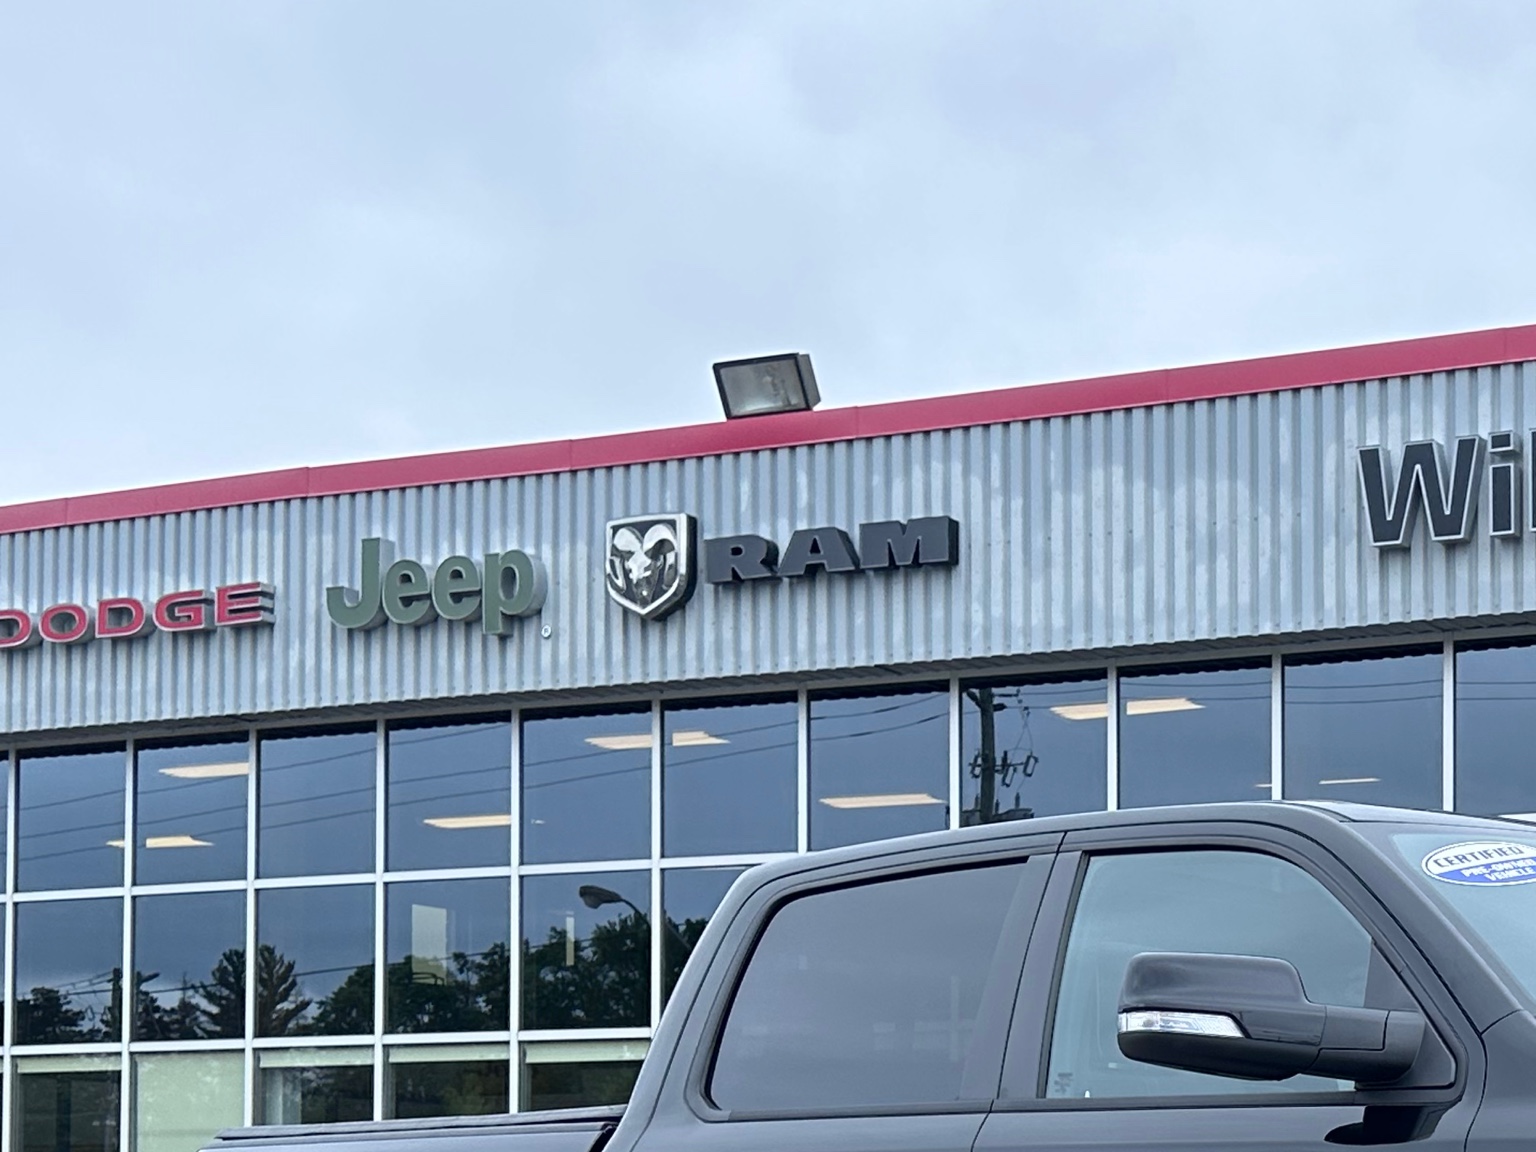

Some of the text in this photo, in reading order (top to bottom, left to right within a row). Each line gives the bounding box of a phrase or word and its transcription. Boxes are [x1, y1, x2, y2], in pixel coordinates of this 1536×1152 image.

[703, 515, 959, 584] RAM
[0, 581, 276, 648] DODGE
[325, 537, 549, 638] Jeep
[1433, 845, 1525, 868] CERTIFIED
[1484, 867, 1536, 881] VEHICLE
